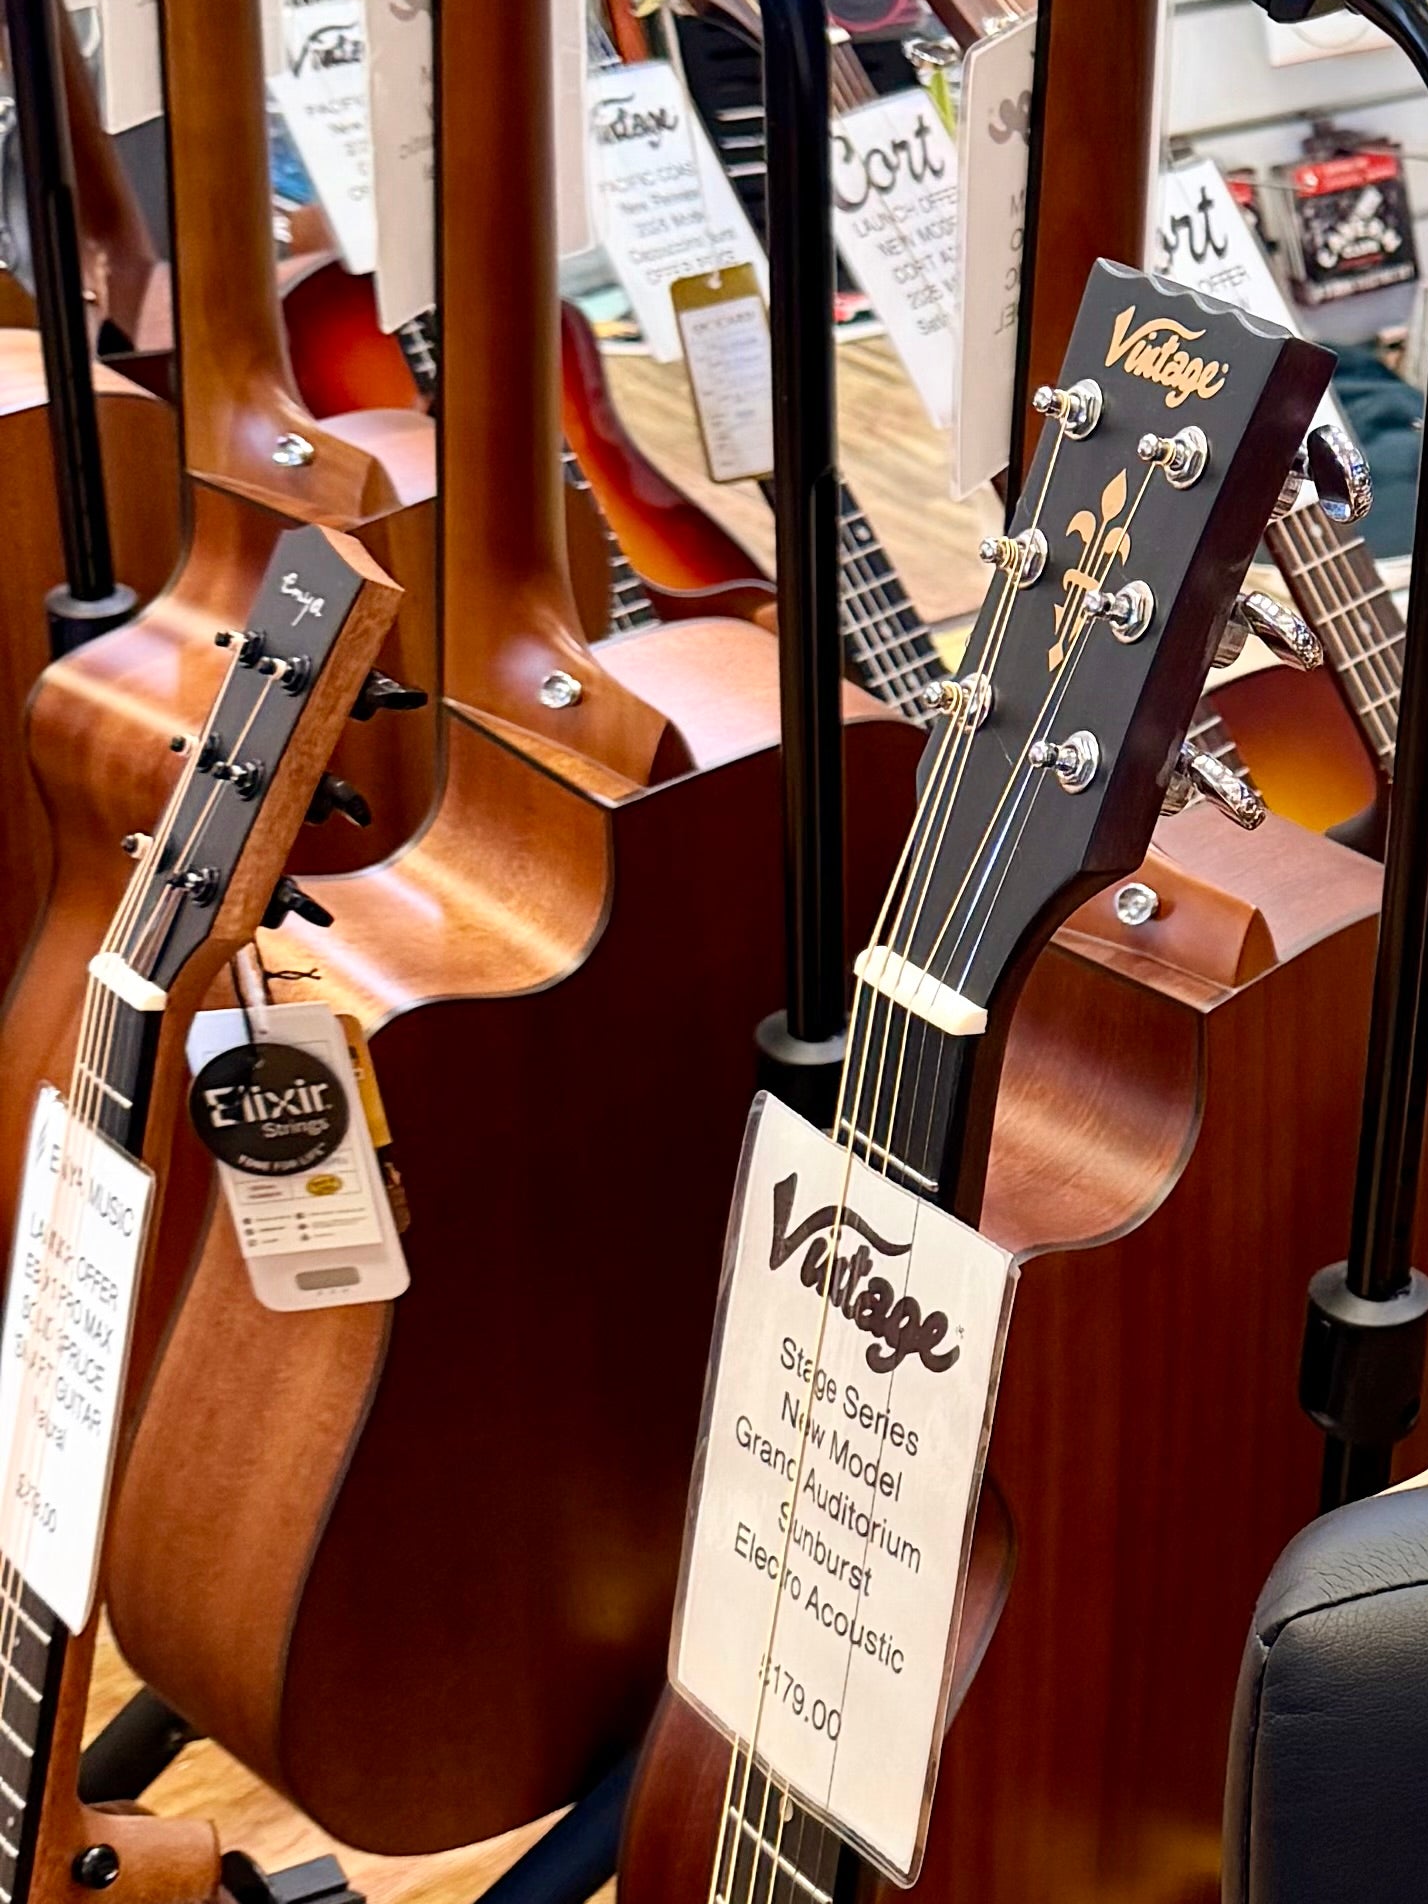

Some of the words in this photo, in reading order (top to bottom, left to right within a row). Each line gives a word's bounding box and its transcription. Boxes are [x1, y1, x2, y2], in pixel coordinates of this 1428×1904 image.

[1104, 303, 1232, 408] Vintage
[280, 572, 325, 626] Enya
[203, 1079, 333, 1129] Elixir
[261, 1117, 332, 1140] Strings
[87, 1175, 136, 1238] MUSIC
[771, 1171, 961, 1375] Vintage
[779, 1335, 839, 1407] Stage
[840, 1384, 921, 1458] Series
[780, 1387, 826, 1441] New
[827, 1430, 904, 1504] Model
[775, 1498, 873, 1600] Sunburst
[803, 1466, 923, 1575] Auditorium
[733, 1519, 803, 1604] Elecro
[803, 1583, 907, 1676] Acoustic
[757, 1654, 845, 1743] £179.00
